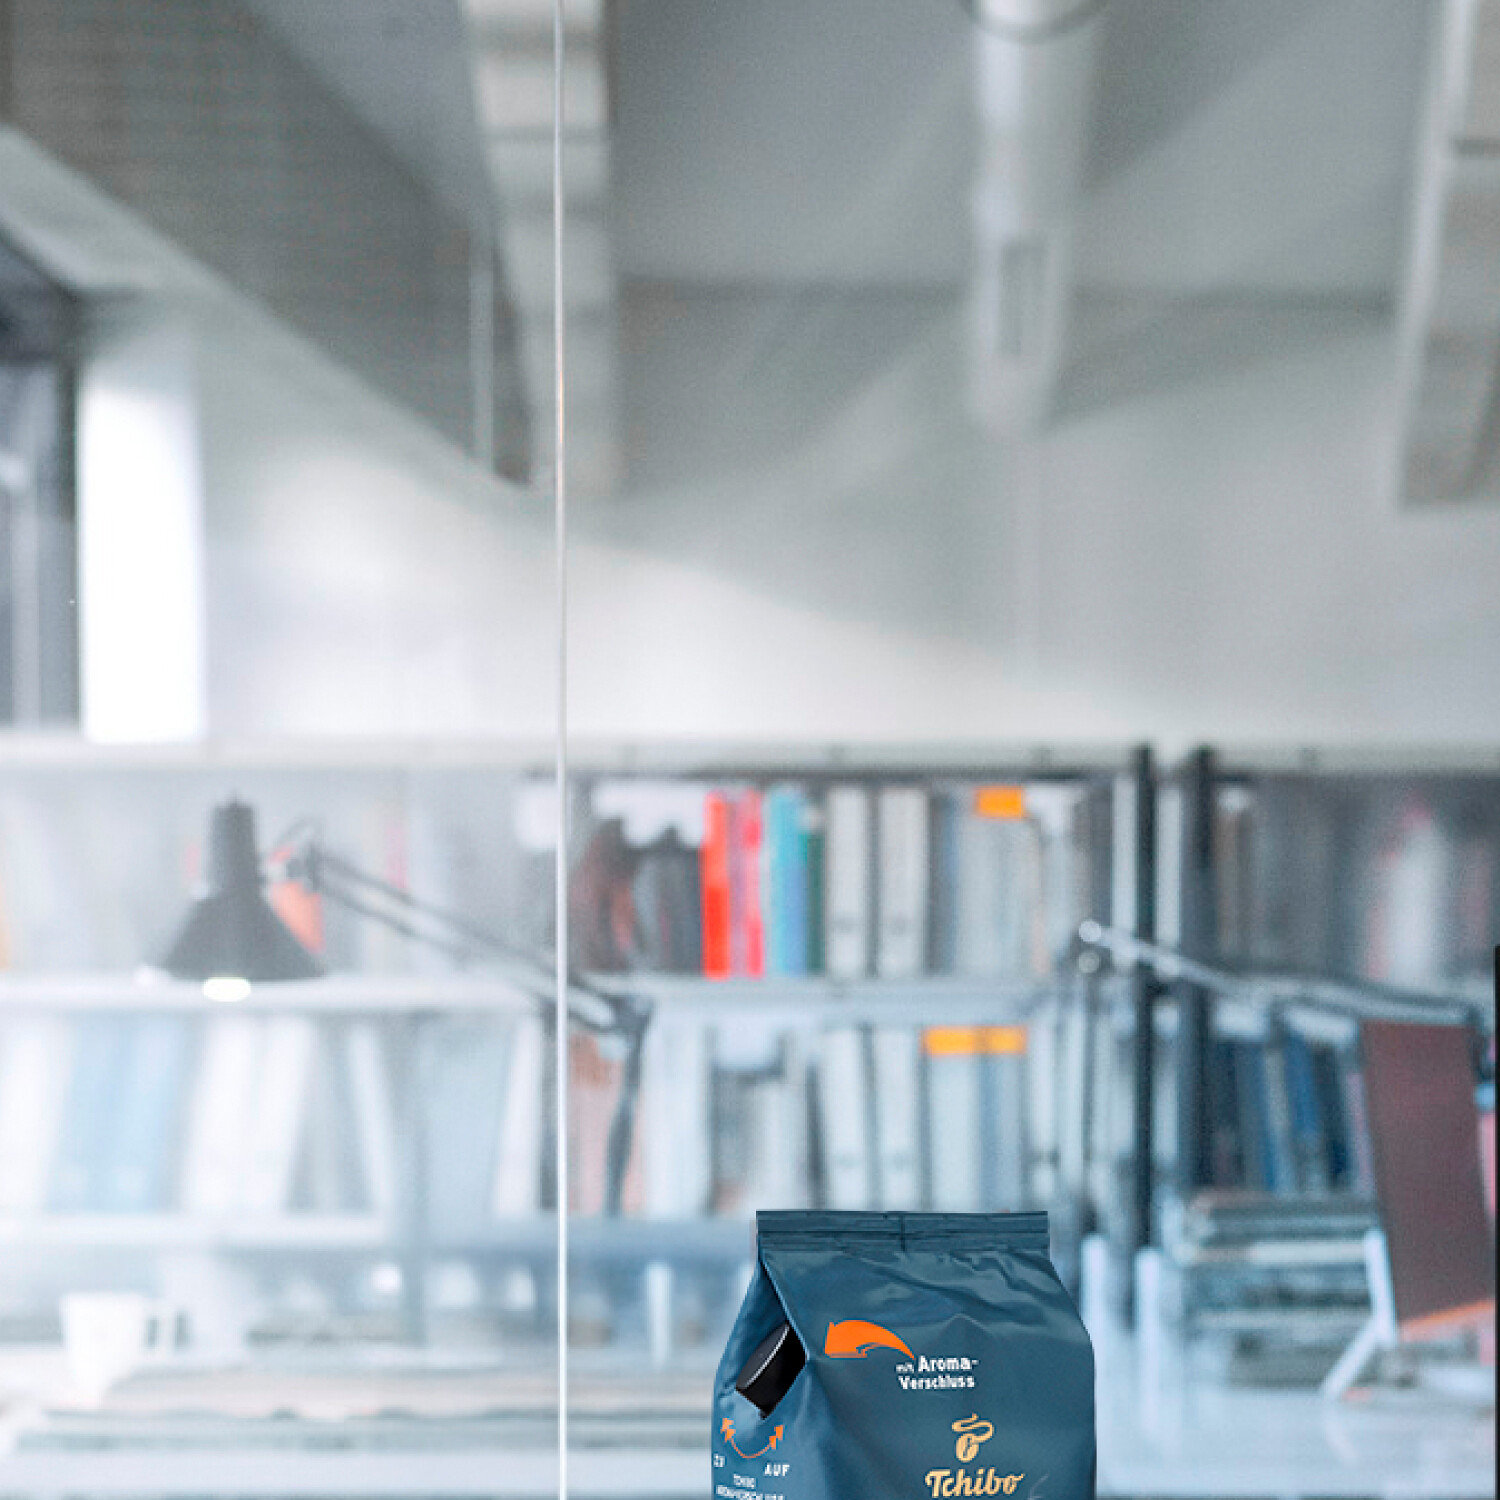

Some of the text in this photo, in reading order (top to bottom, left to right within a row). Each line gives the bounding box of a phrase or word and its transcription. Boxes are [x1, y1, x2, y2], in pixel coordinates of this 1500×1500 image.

[918, 1355, 979, 1372] Aroma-
[898, 1374, 976, 1390] Verschluss
[764, 1463, 790, 1477] AUF
[924, 1467, 1025, 1498] Tchibo
